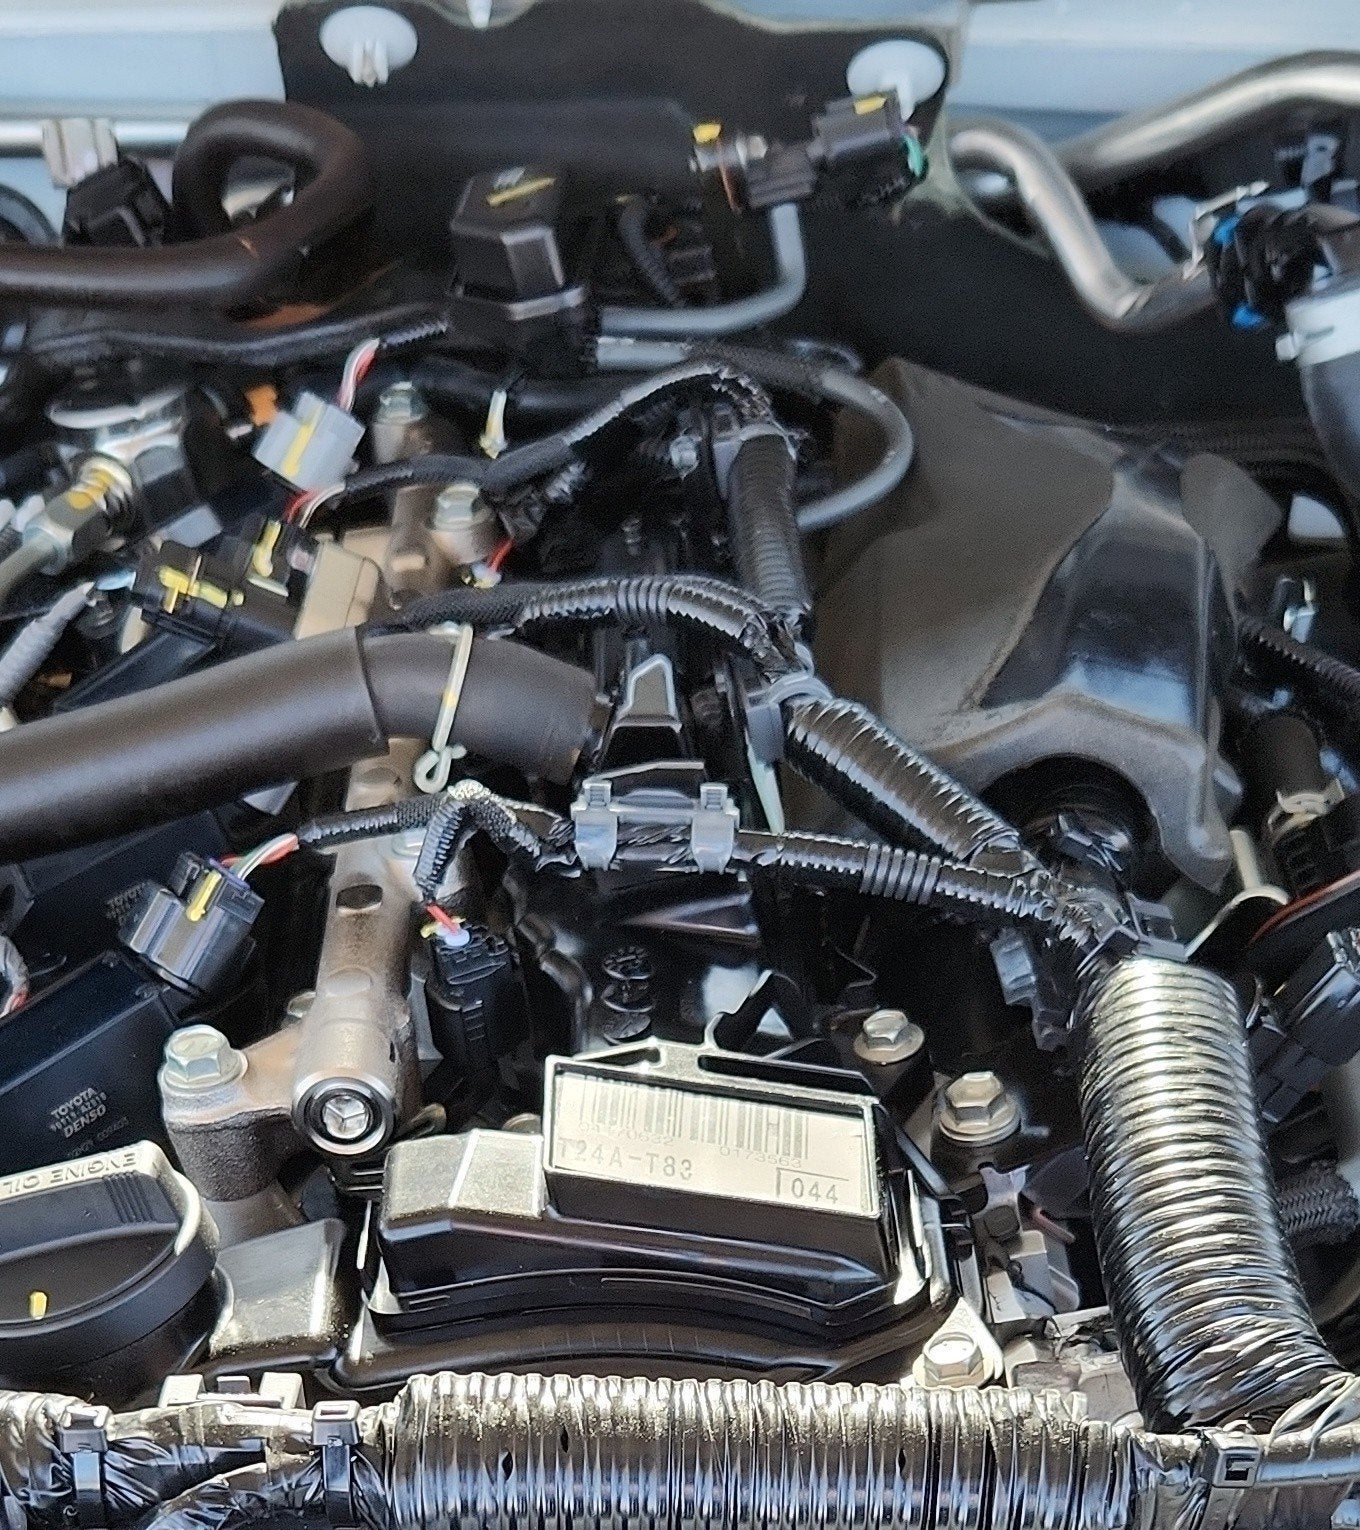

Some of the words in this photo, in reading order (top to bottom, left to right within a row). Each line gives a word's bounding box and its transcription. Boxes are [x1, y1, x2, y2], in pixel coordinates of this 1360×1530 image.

[50, 1087, 98, 1119] TOYOTA
[63, 1104, 106, 1138] DENSO
[2, 1174, 40, 1194] OIL
[50, 1152, 136, 1184] ENGINE
[790, 1177, 838, 1204] 044
